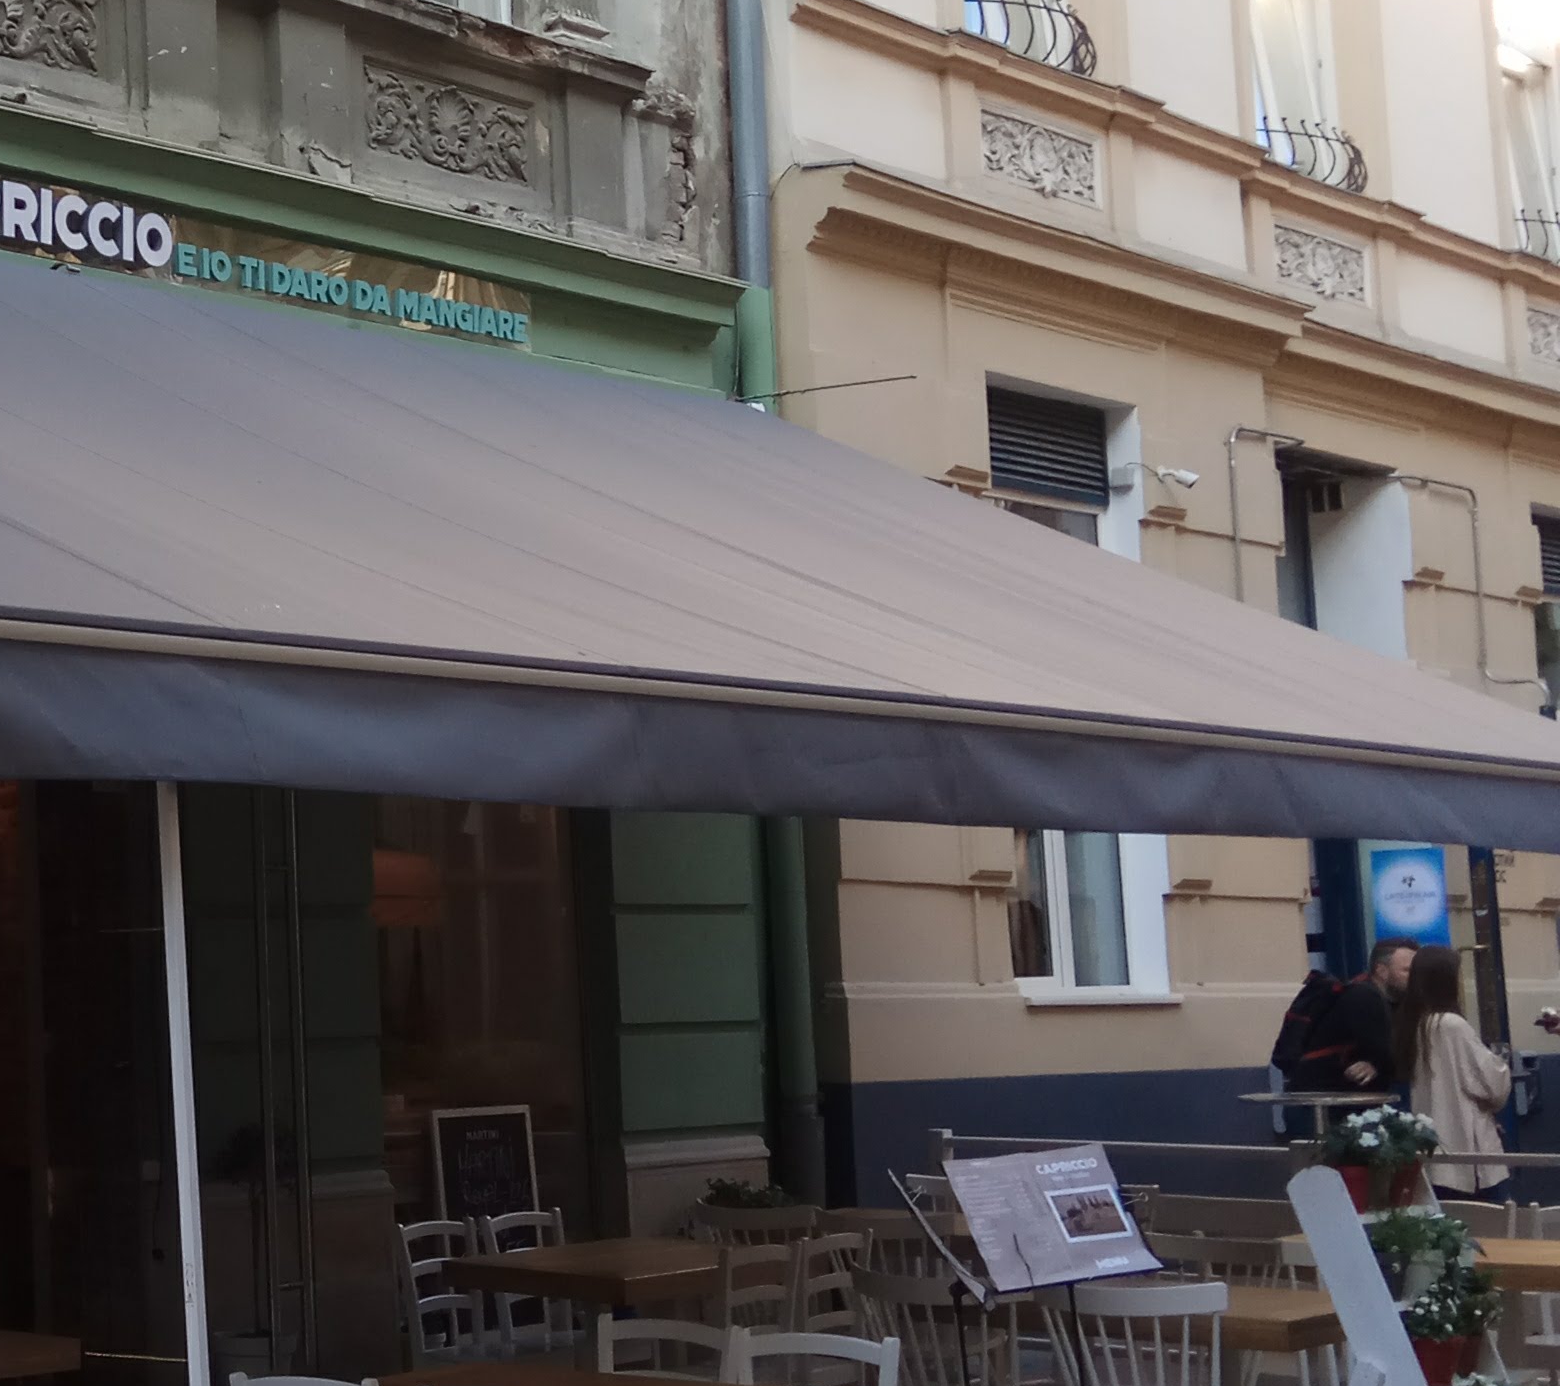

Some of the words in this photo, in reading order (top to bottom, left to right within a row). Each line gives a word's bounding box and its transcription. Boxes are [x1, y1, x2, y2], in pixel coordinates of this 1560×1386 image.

[175, 242, 198, 277] E
[201, 247, 233, 282] IO
[237, 255, 265, 291] TI
[270, 262, 350, 306] DARO
[351, 279, 392, 317] DA
[396, 288, 530, 344] MANGIARE
[466, 1130, 500, 1141] MARTINI
